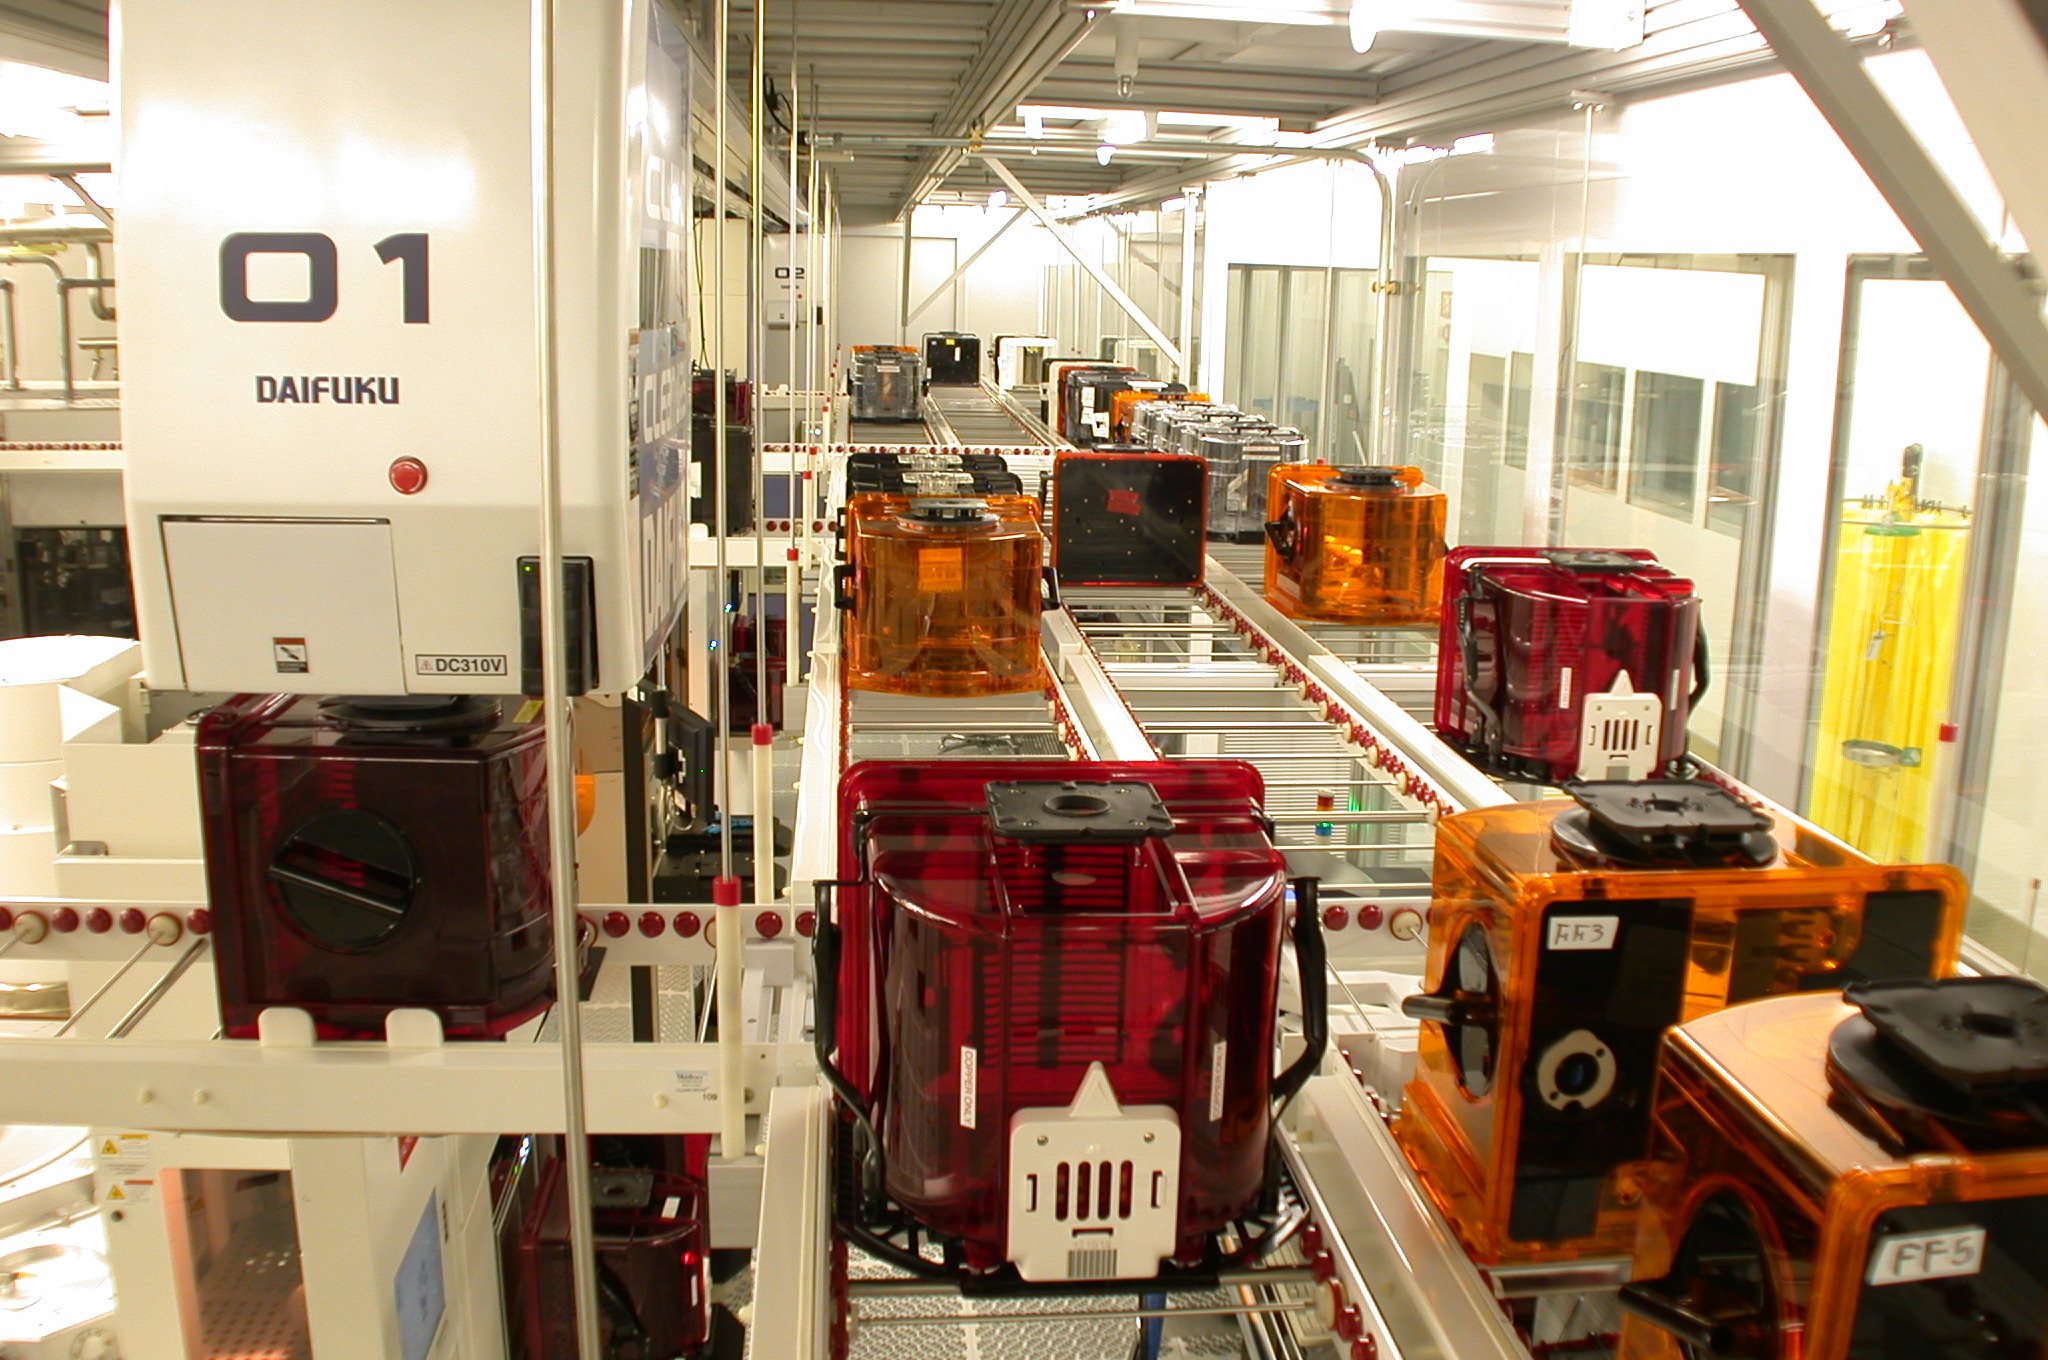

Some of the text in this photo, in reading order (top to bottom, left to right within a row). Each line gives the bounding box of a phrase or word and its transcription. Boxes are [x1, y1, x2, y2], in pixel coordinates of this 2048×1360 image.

[256, 375, 400, 404] DAIFUKU
[435, 658, 502, 672] DC310V
[1554, 923, 1605, 945] FF3
[963, 1050, 974, 1126] COPPER ONLY
[1892, 1236, 1975, 1276] FF5
